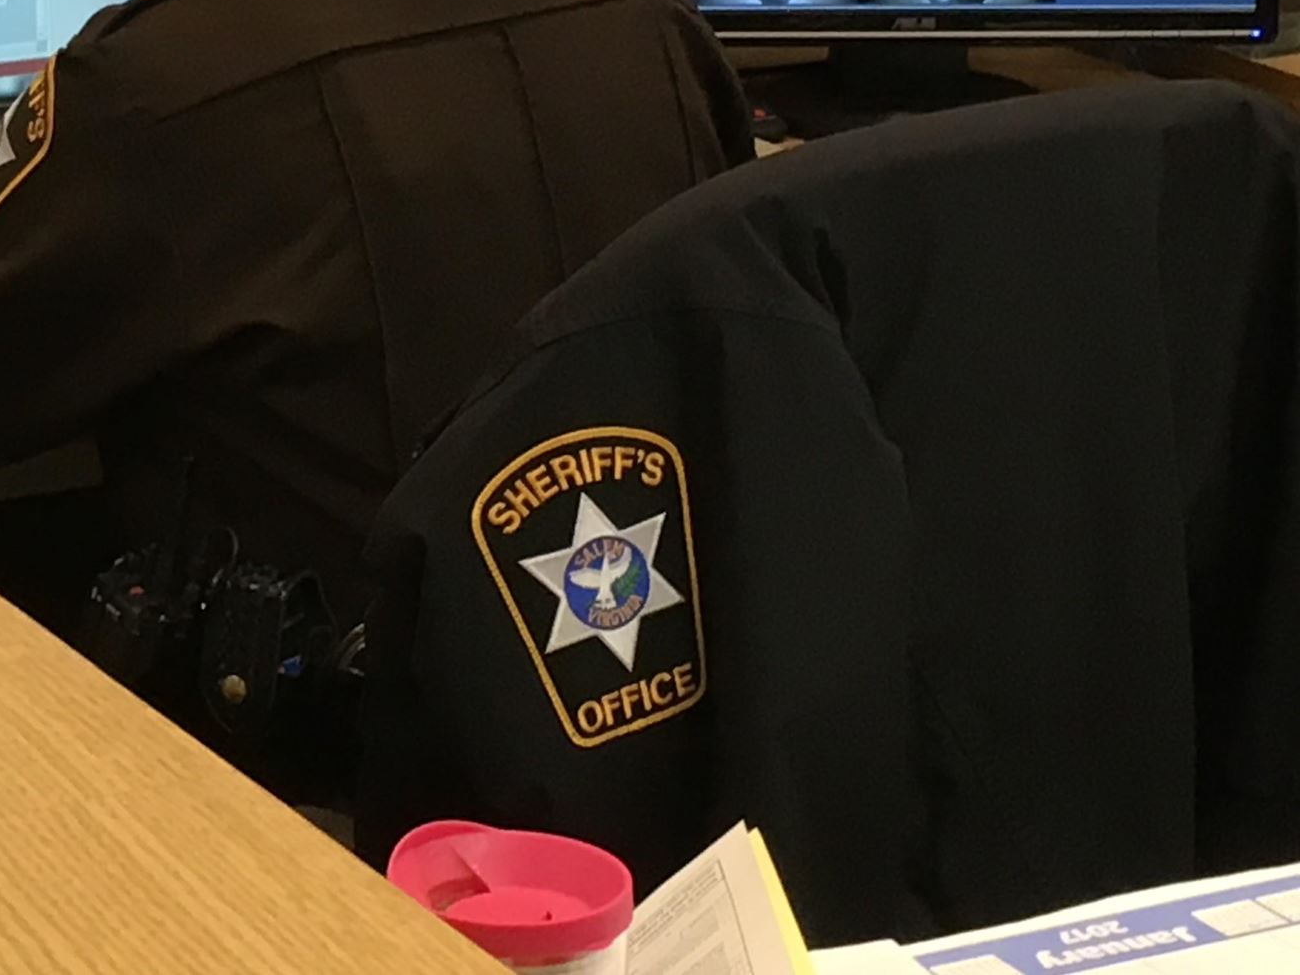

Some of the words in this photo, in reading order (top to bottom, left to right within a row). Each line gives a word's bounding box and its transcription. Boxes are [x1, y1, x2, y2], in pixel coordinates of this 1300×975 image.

[487, 445, 667, 536] SHERIFF'S
[576, 662, 698, 735] OFFICE
[1035, 926, 1197, 970] January
[1059, 920, 1130, 945] 2017
